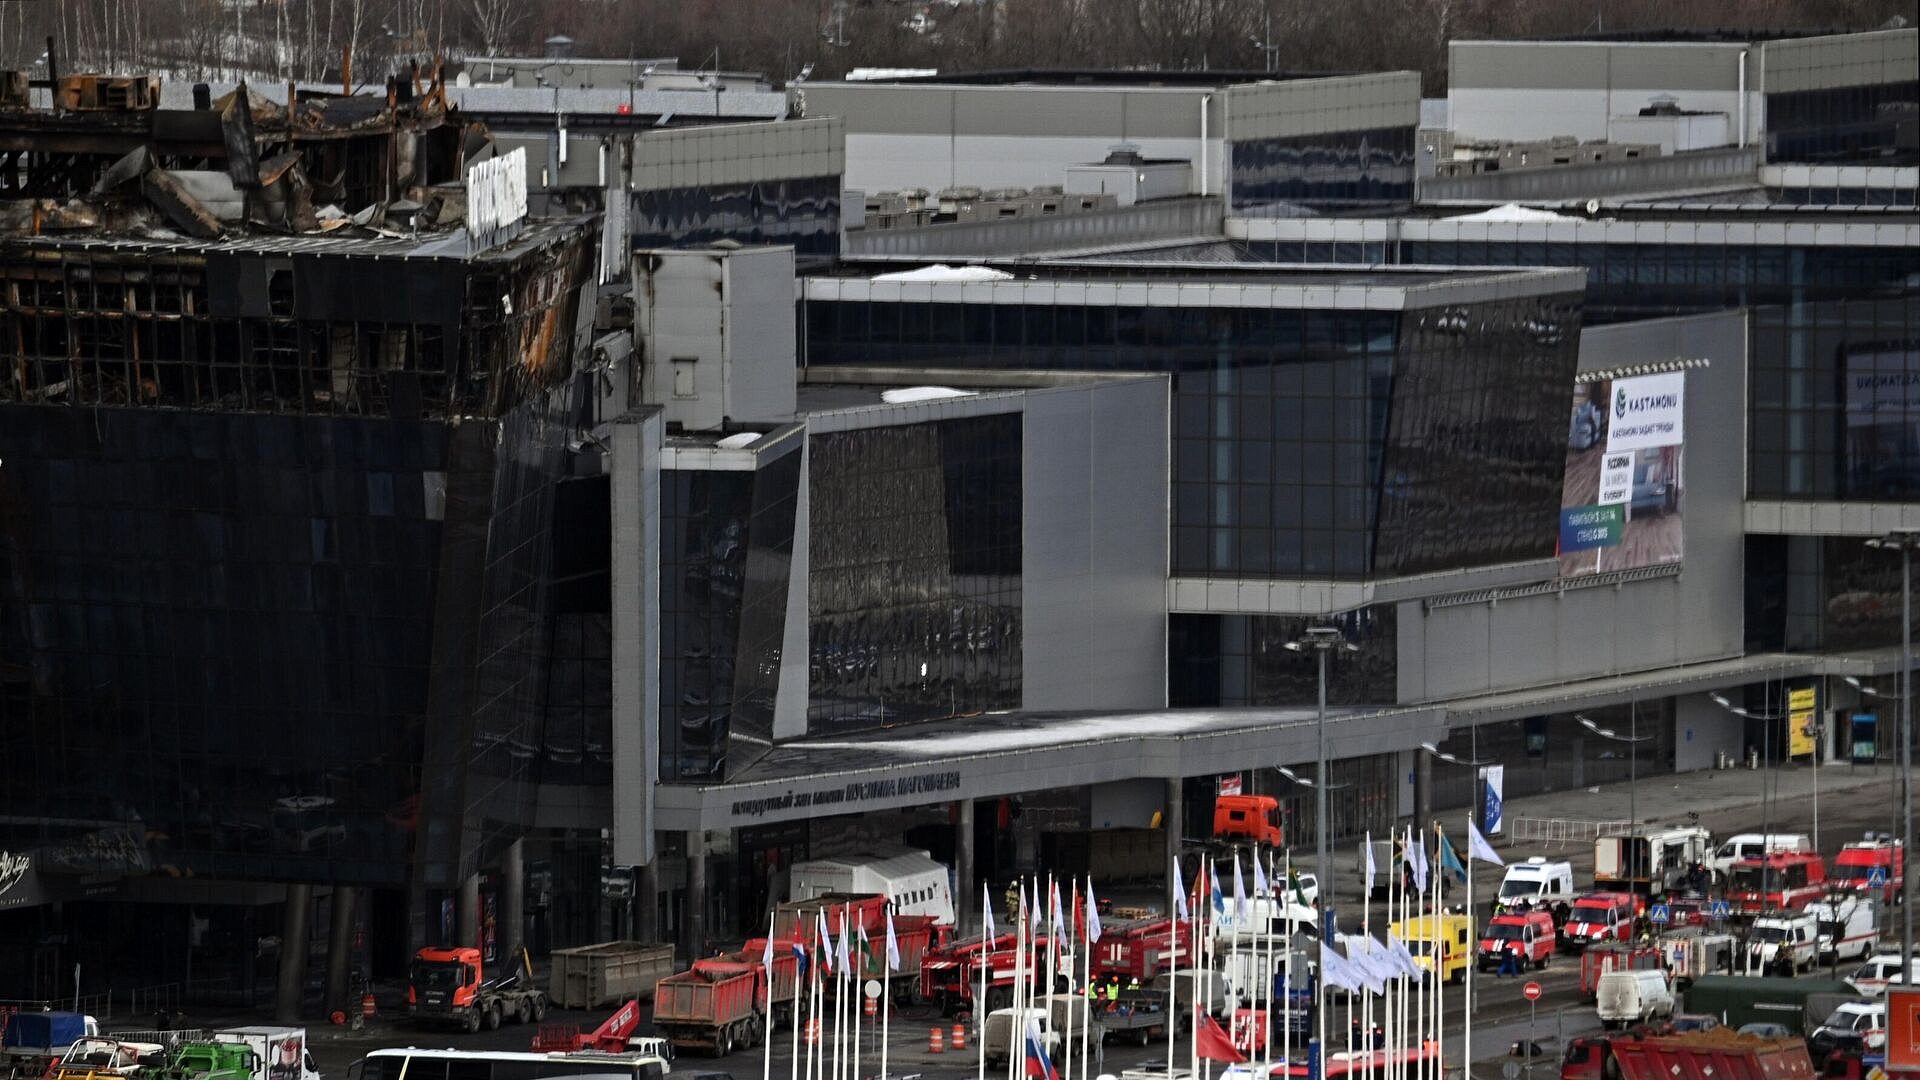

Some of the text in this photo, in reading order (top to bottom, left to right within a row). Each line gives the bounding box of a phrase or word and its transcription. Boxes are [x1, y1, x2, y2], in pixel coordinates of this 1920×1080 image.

[1629, 394, 1677, 413] KASTAMONU
[845, 779, 896, 802] МУСЛИМА
[897, 770, 961, 796] МАГОМАЕВА
